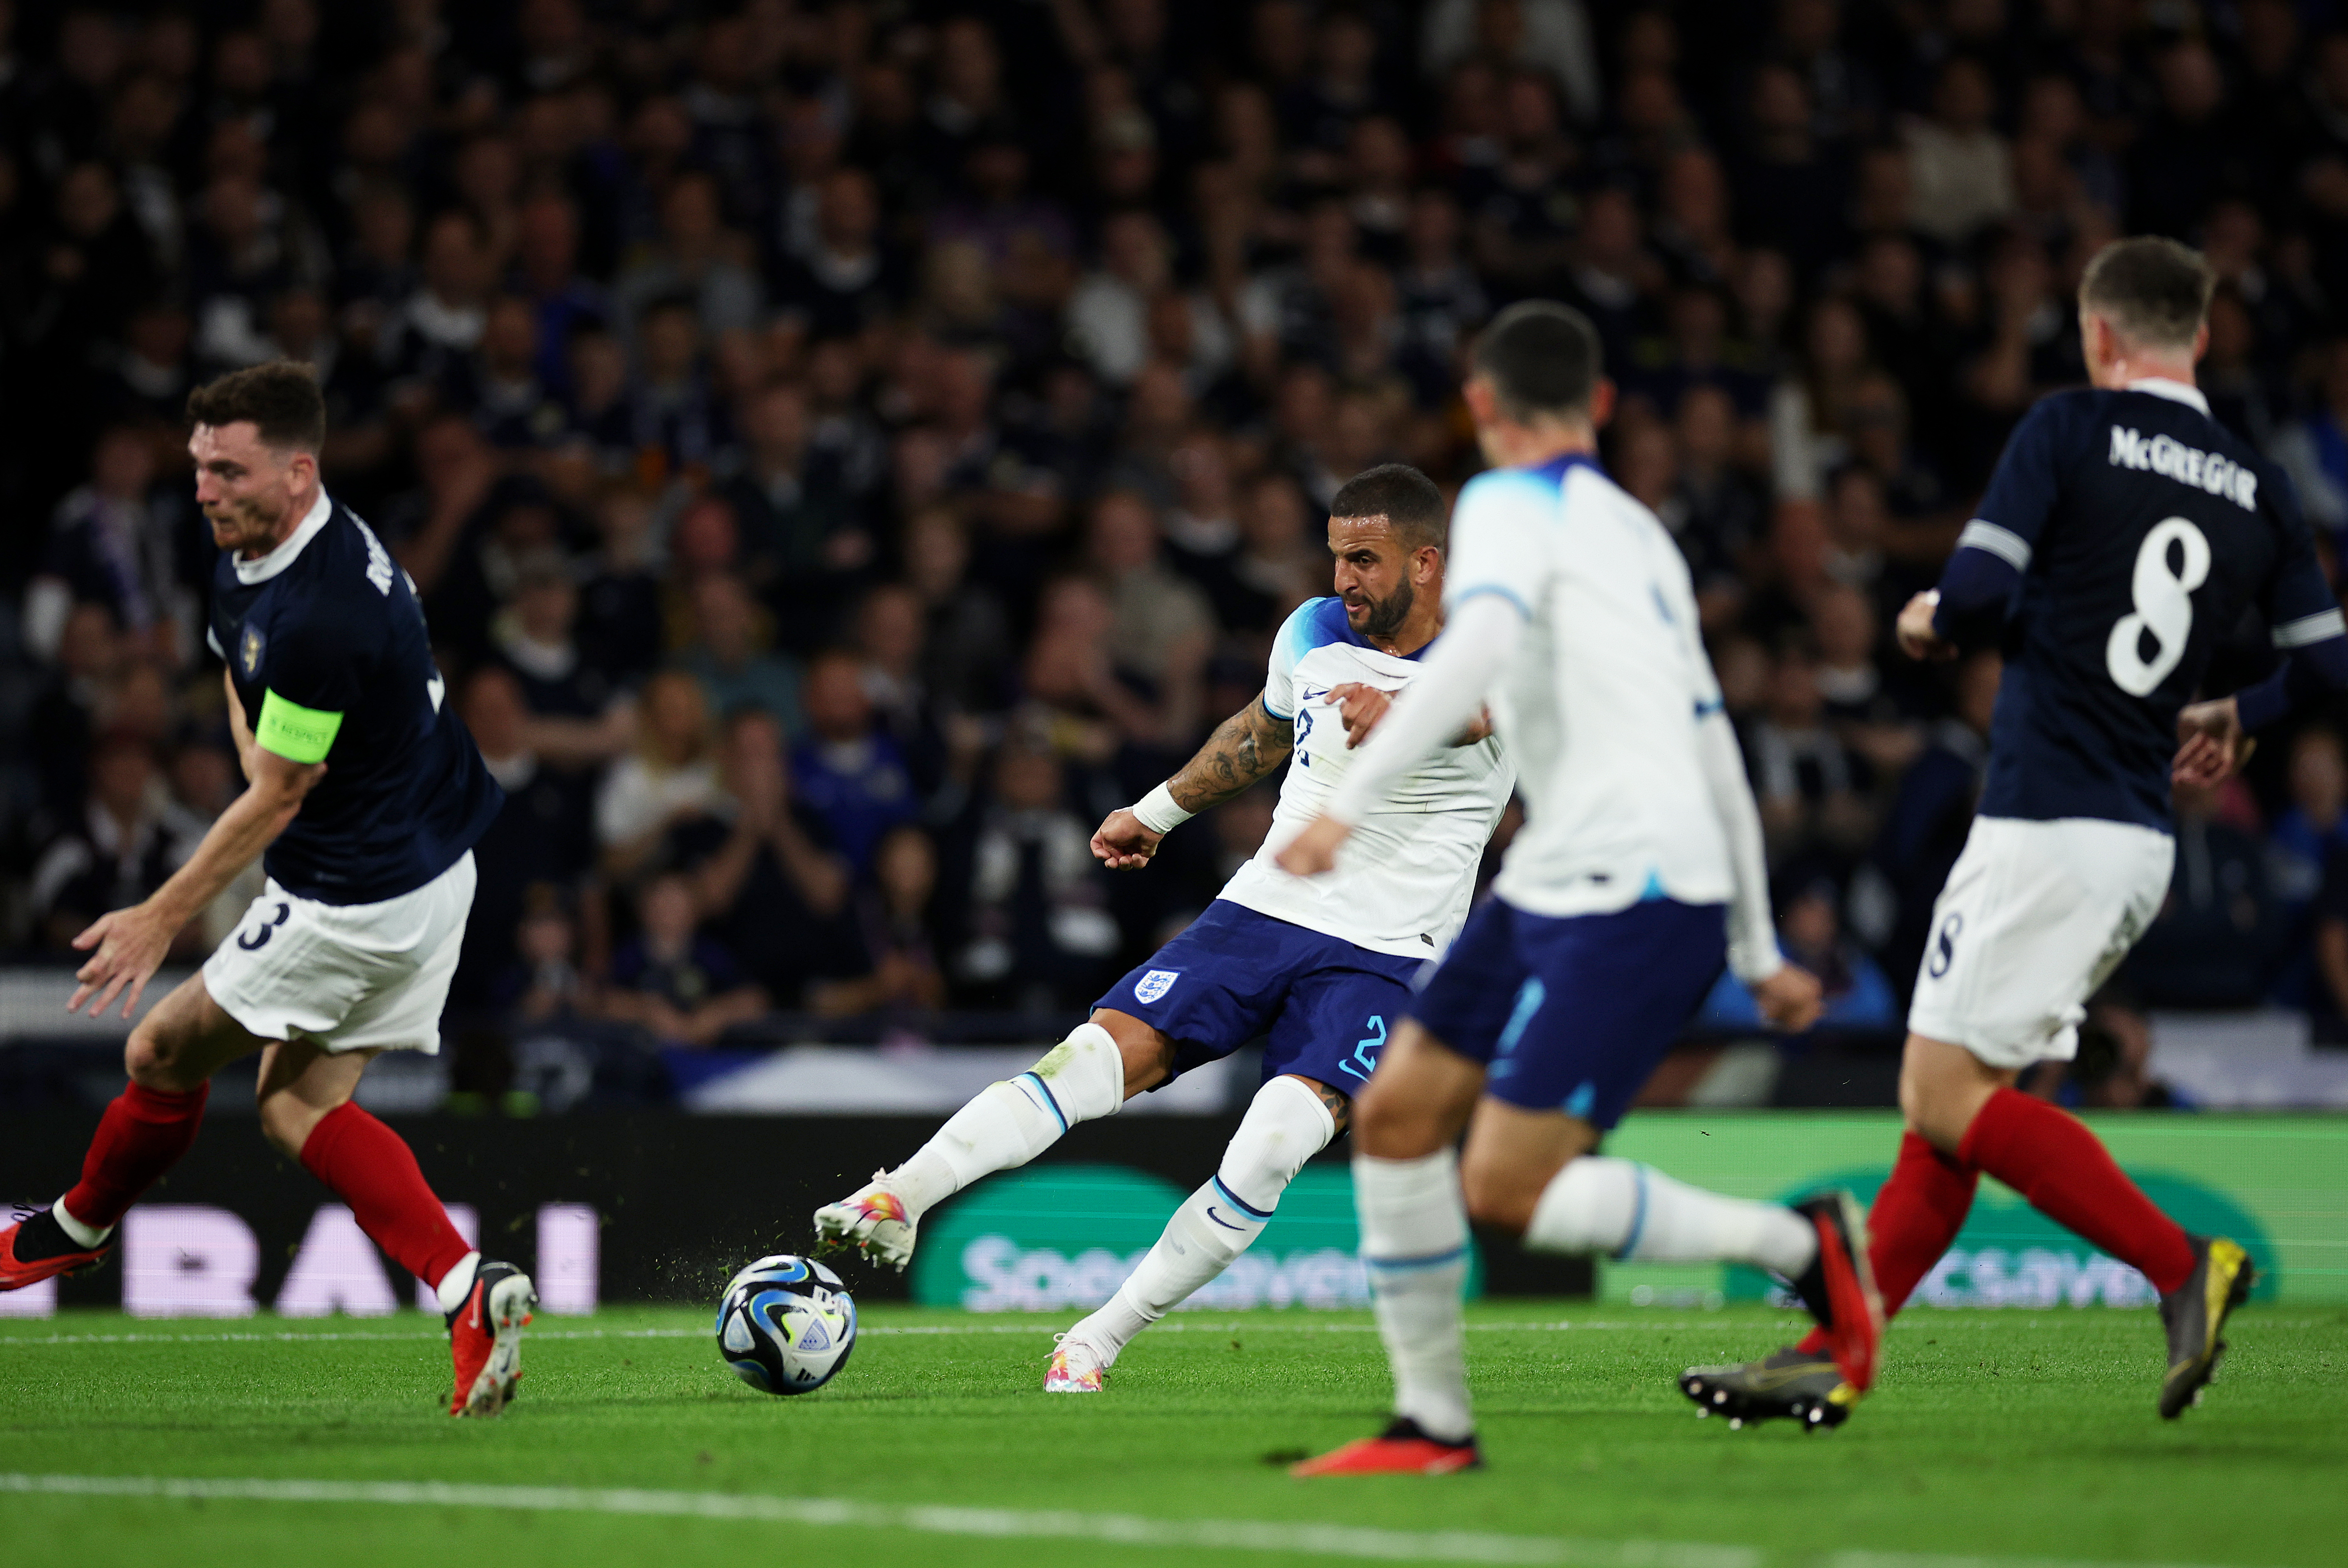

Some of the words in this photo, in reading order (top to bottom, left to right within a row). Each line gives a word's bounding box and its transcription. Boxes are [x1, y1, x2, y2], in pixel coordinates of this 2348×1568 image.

[2109, 424, 2258, 512] McGREGOR
[2106, 516, 2211, 698] 8
[1296, 707, 1314, 768] 2
[238, 902, 290, 951] 3
[1929, 910, 1963, 980] 8
[1354, 1015, 1387, 1073] 2
